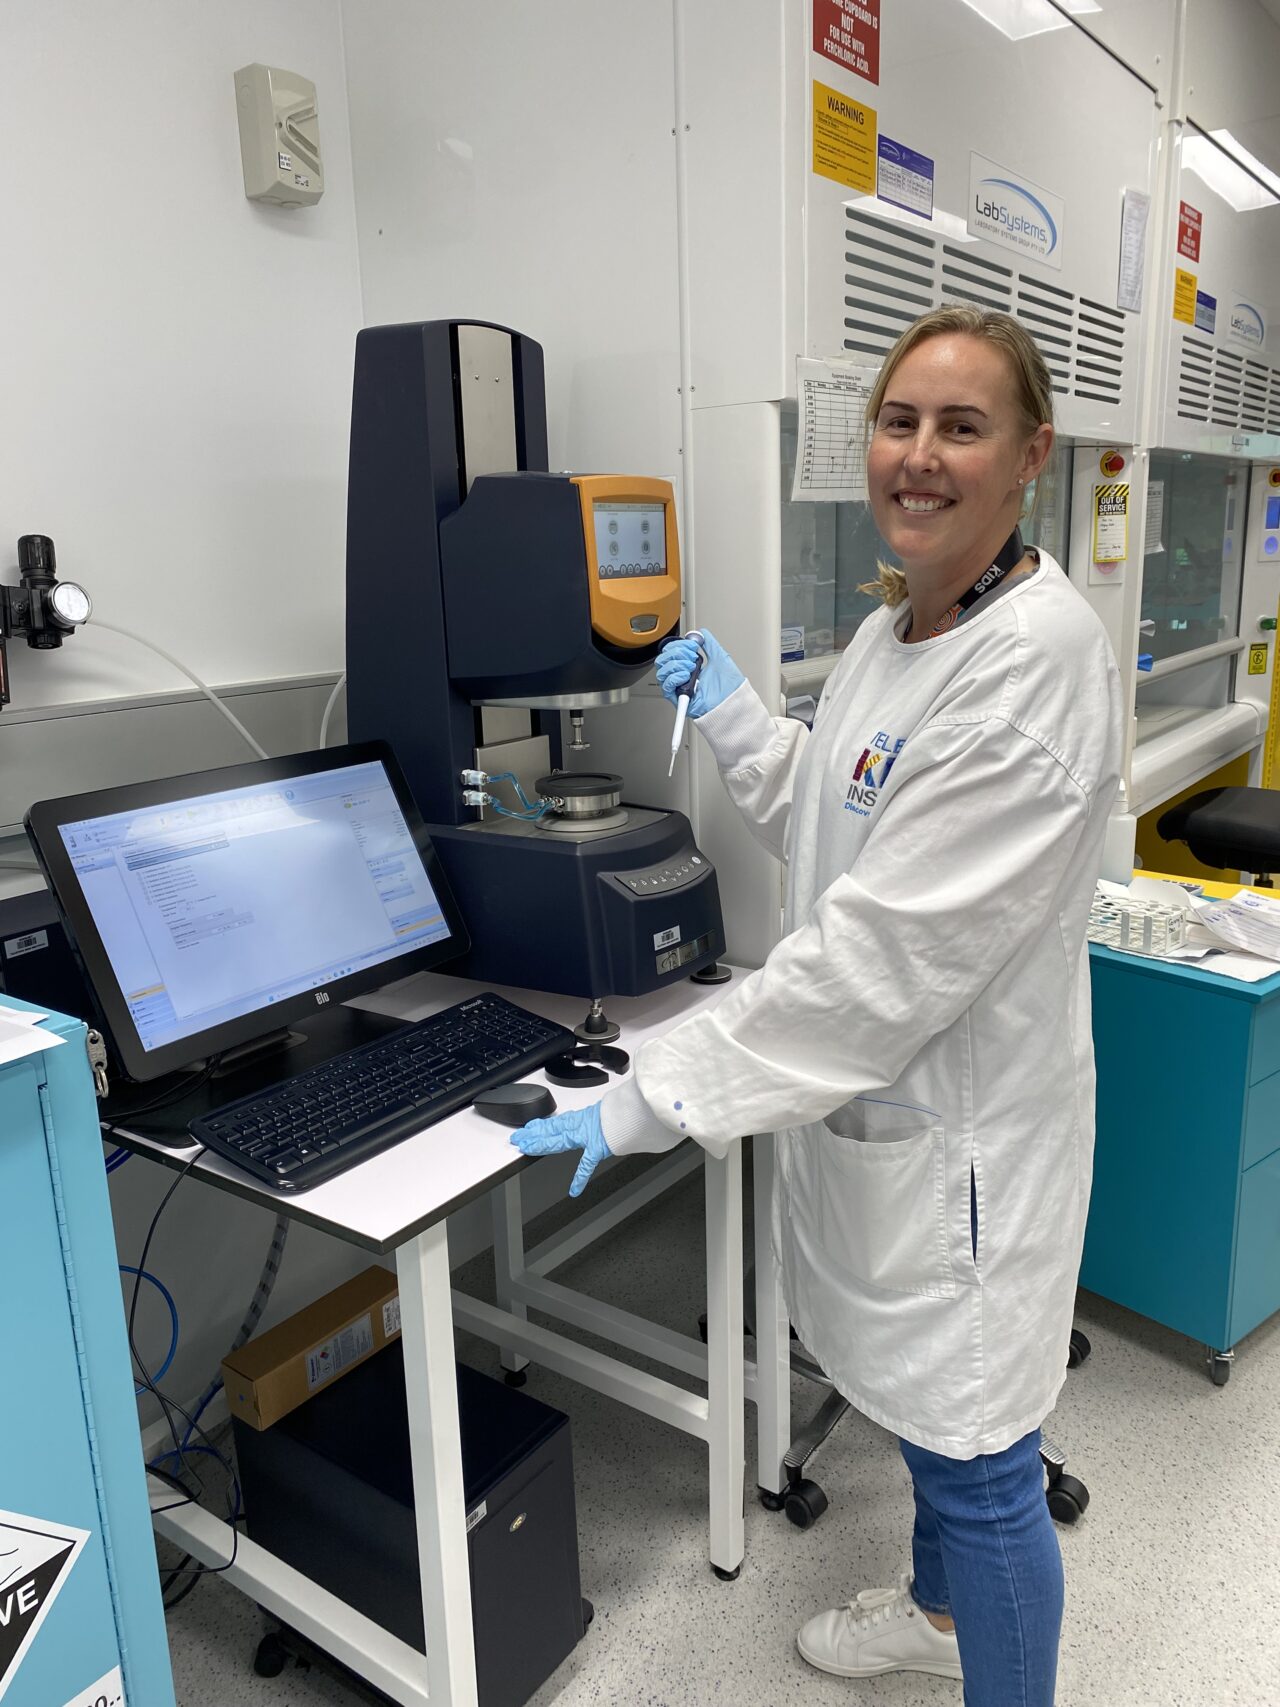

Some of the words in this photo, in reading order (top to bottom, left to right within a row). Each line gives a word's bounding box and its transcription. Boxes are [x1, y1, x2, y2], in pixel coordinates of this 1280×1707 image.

[841, 12, 854, 33] NOT
[844, 0, 872, 26] CUPBOARD
[872, 15, 878, 30] IS
[823, 37, 856, 67] PERCHLORIC
[829, 24, 841, 42] FOR
[840, 31, 851, 48] USE
[851, 37, 865, 56] WITH
[827, 95, 865, 125] WARNING
[976, 194, 1046, 242] LabSystems
[1098, 504, 1126, 512] SERVICE
[1115, 496, 1124, 504] OF
[974, 564, 1001, 593] KIDS
[846, 783, 878, 807] INS
[460, 999, 484, 1012] Microsoft
